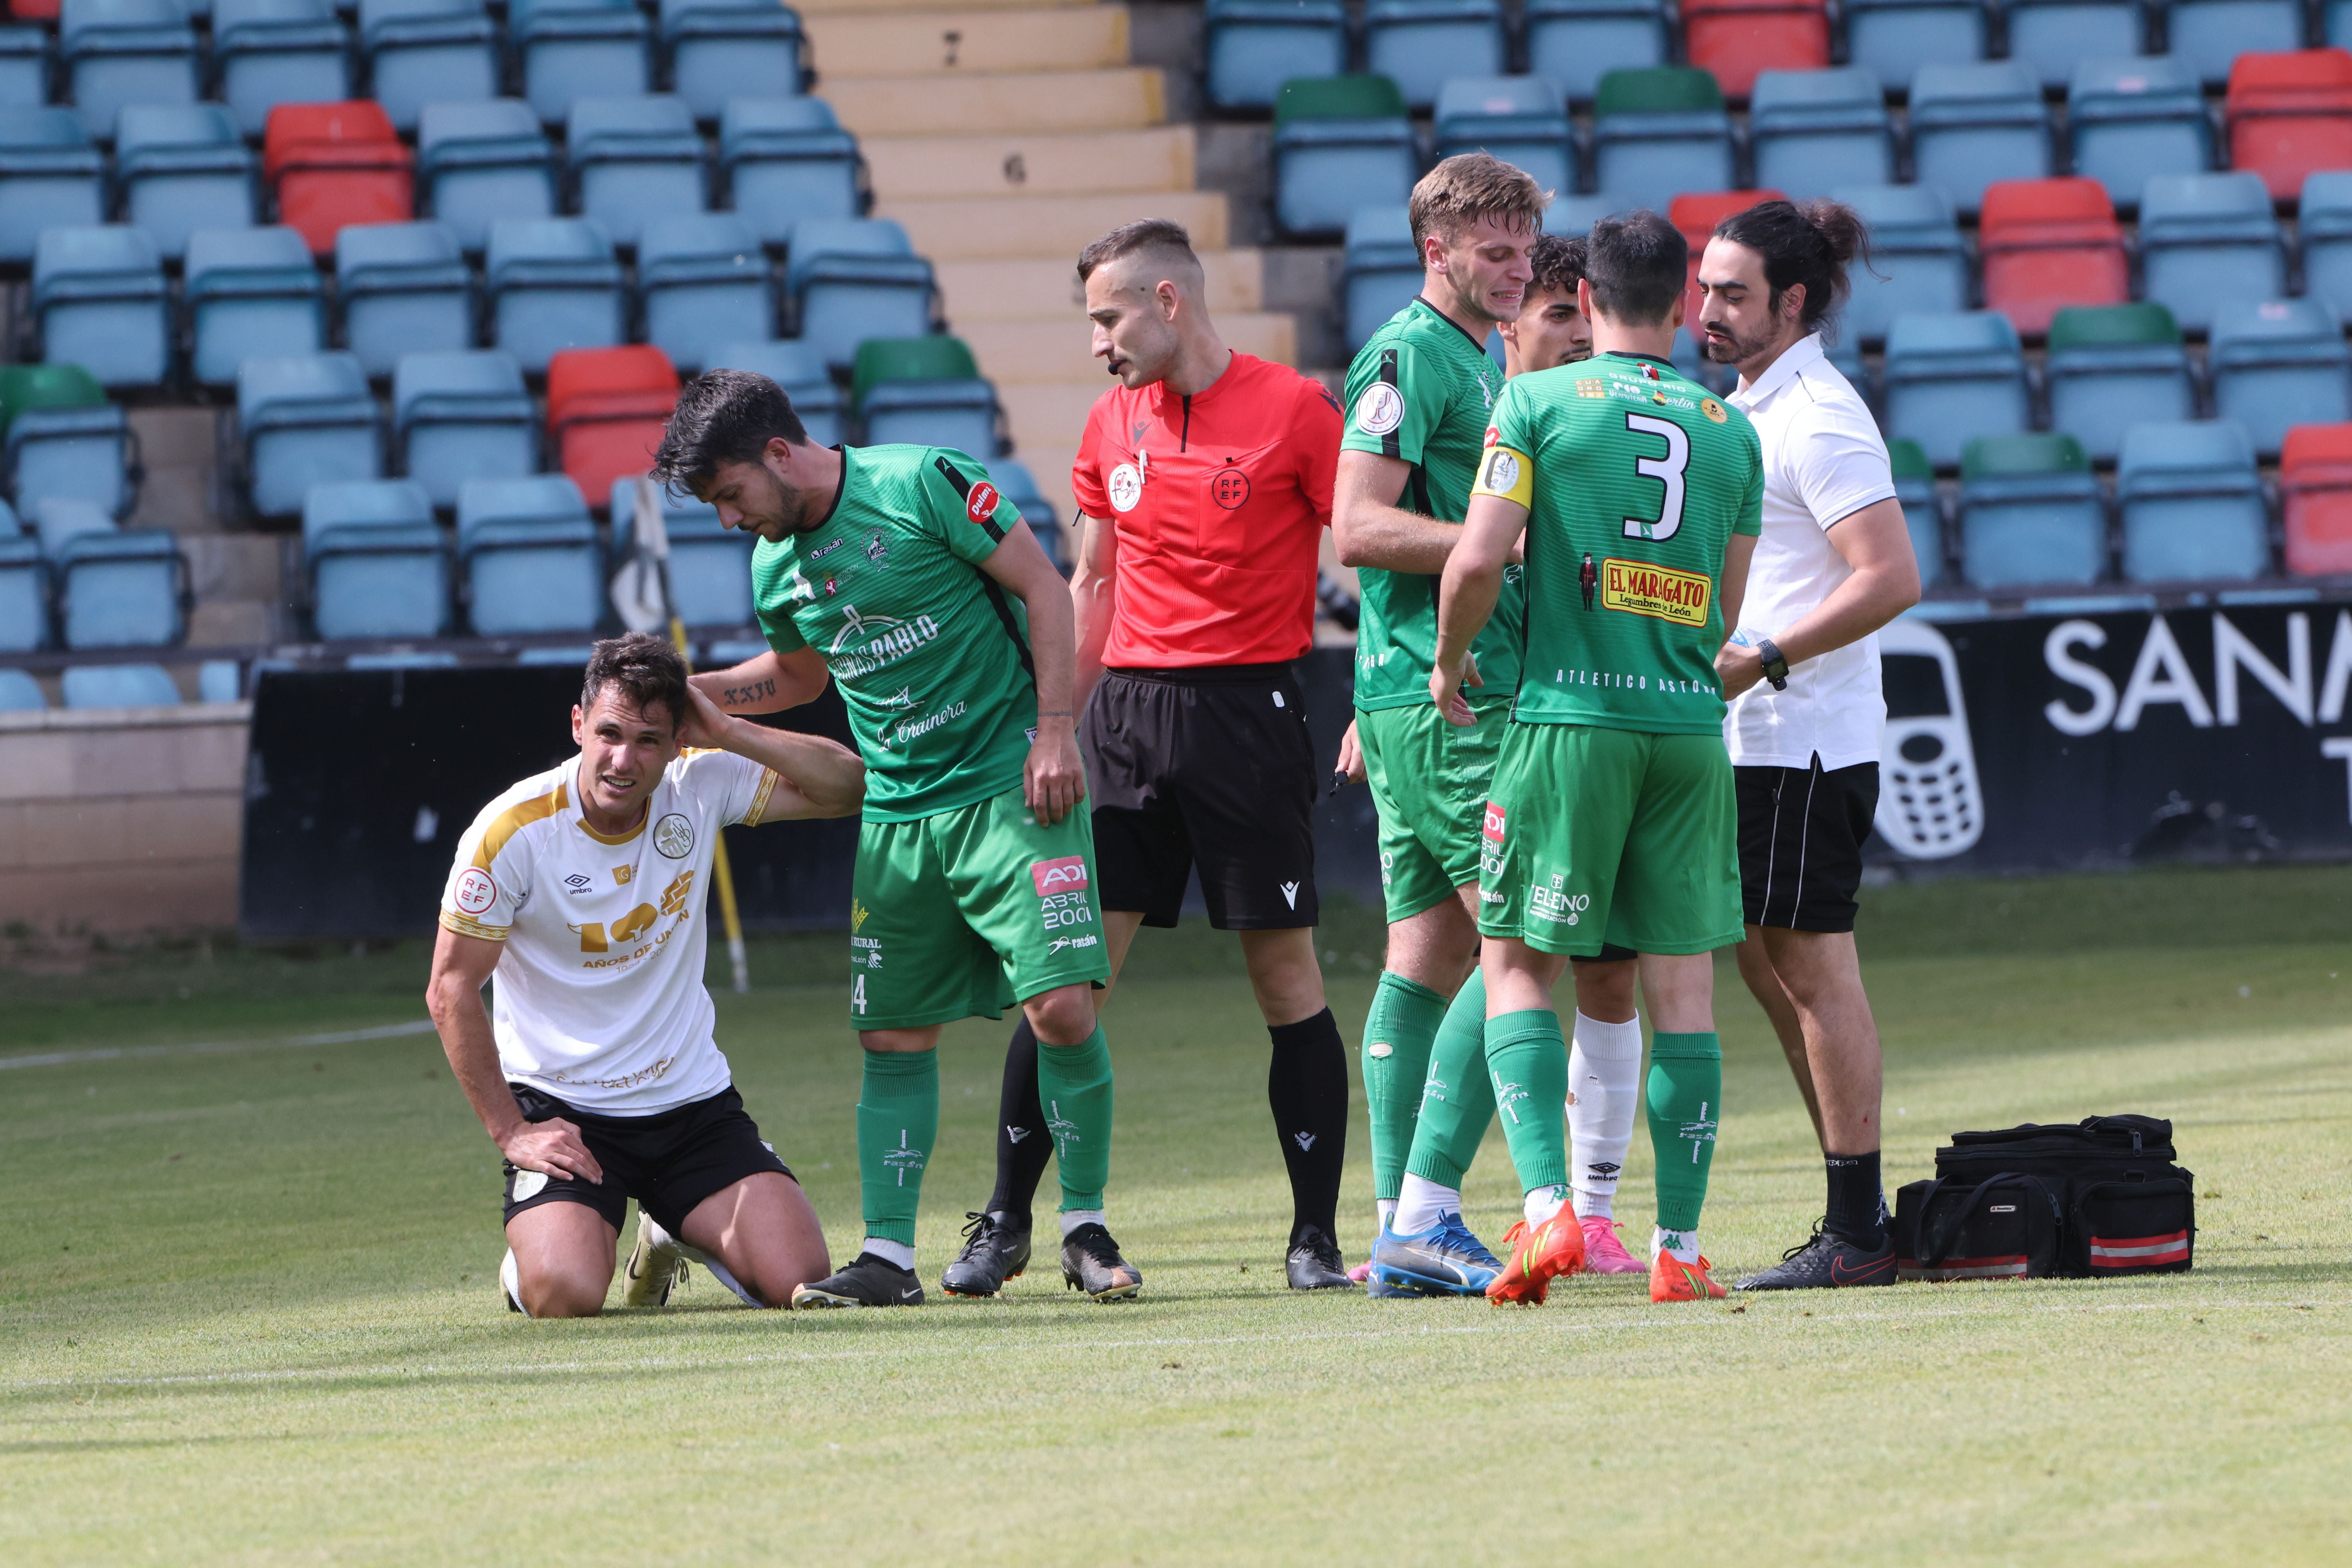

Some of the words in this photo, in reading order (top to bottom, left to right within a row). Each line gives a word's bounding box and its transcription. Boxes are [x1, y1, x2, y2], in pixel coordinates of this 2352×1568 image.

[1608, 372, 1657, 387] GRUPO
[1624, 410, 1691, 543] 3
[819, 537, 843, 557] rasán
[1610, 567, 1626, 592] EL
[1628, 570, 1704, 607] MARAGATO
[1619, 593, 1662, 608] Legumbres
[1669, 604, 1691, 617] León
[870, 614, 938, 667] PABLO
[1556, 669, 1646, 690] ATLETICO
[1041, 891, 1087, 912] ABRIL
[1042, 906, 1093, 930] 2001
[853, 937, 882, 949] RURAL
[1071, 933, 1097, 949] rasán
[583, 955, 630, 968] AÑOS
